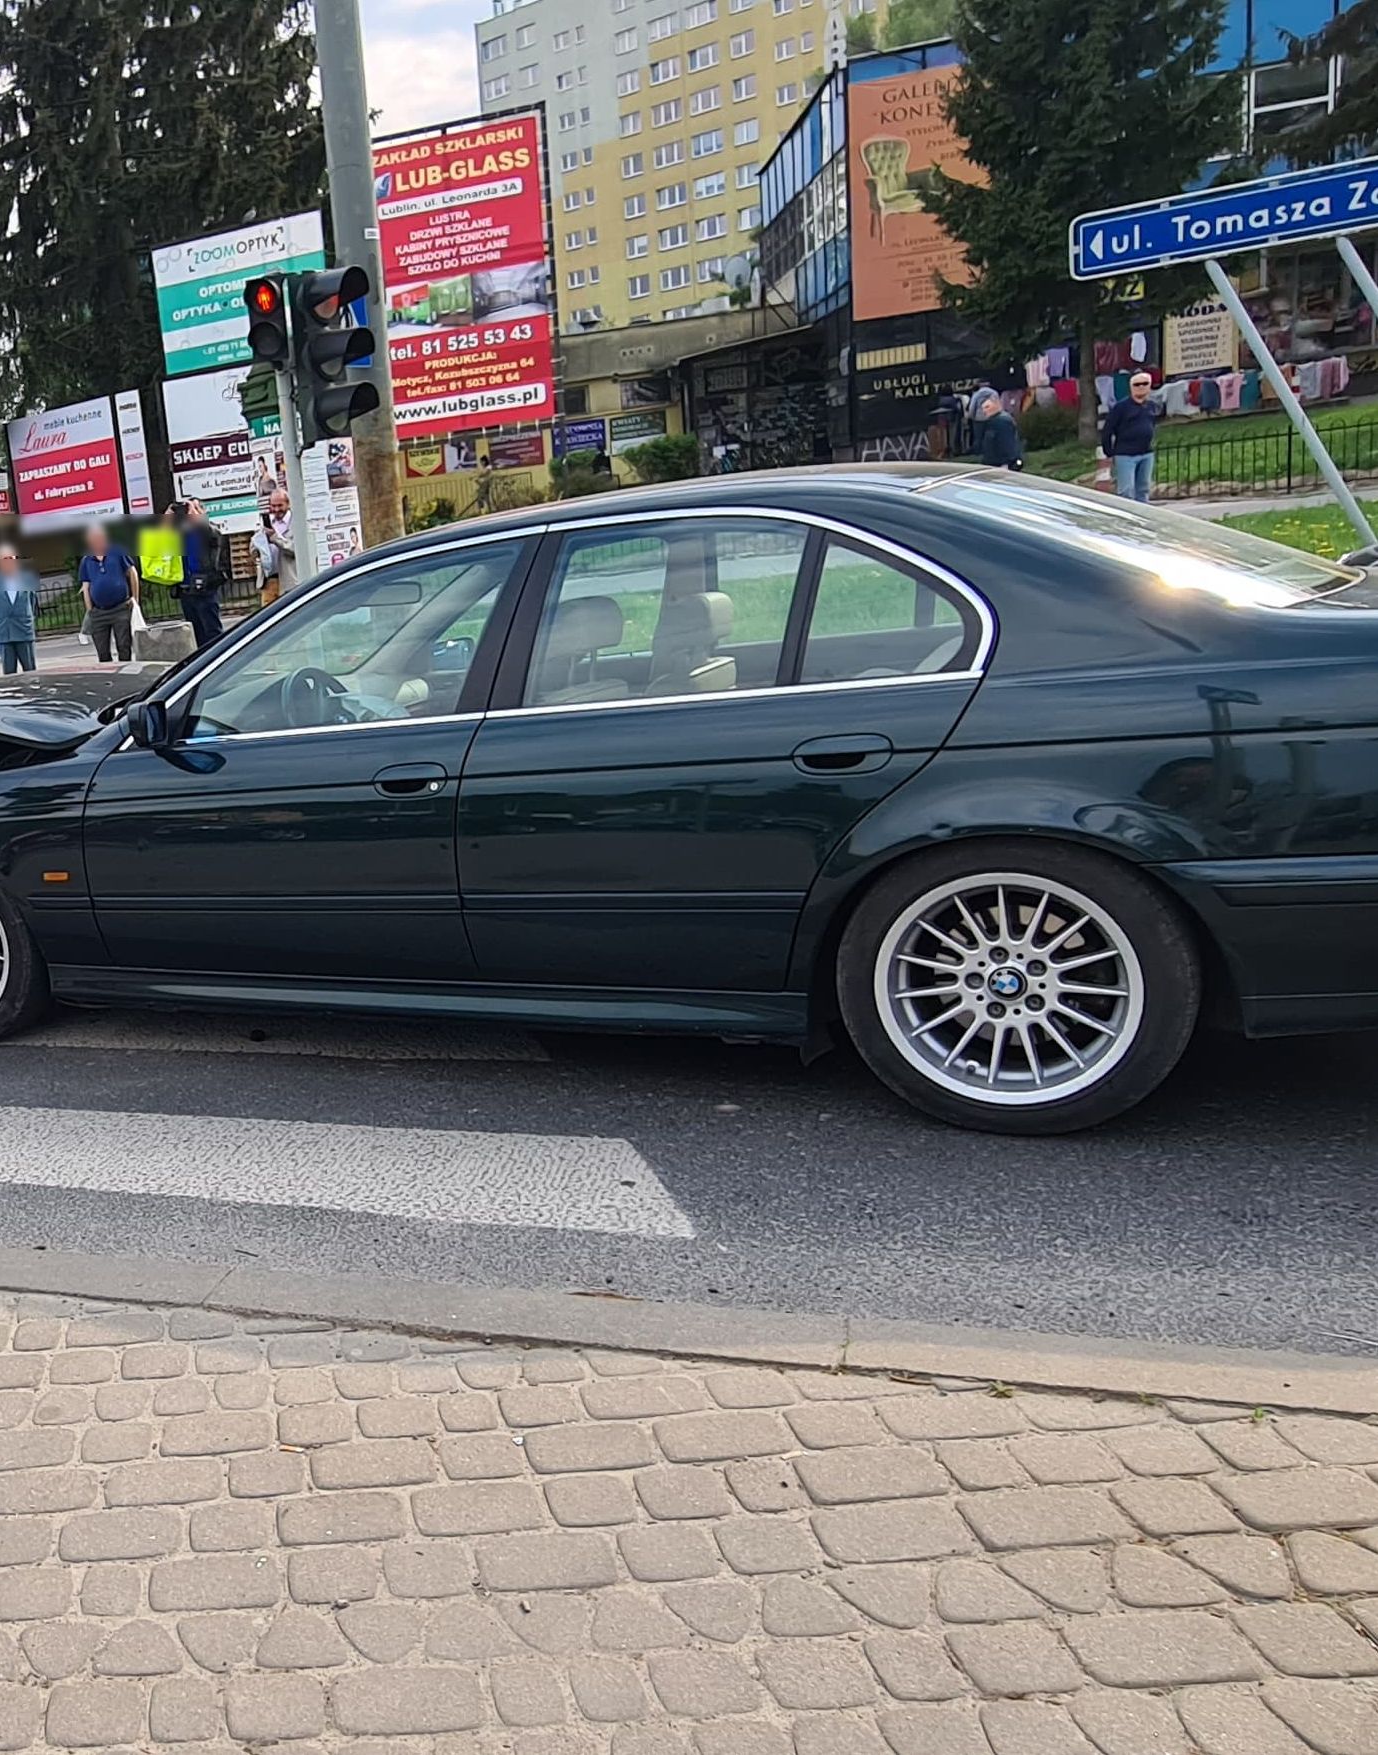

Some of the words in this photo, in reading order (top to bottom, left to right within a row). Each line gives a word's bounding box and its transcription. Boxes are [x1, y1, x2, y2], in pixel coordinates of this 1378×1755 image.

[881, 101, 947, 125] KONES
[373, 146, 431, 168] ZAKŁAD
[434, 126, 523, 155] SZKLARSKI
[395, 148, 531, 192] LUB-GLASS
[424, 197, 437, 208] ul.
[442, 187, 498, 204] Leonarda
[501, 182, 518, 193] 3A
[410, 226, 443, 241] DRZWI
[445, 217, 493, 233] SZKLANE
[429, 210, 471, 226] LUSTRA
[1112, 224, 1153, 254] ul.
[1172, 196, 1331, 242] Tomasza
[193, 233, 280, 265] ZOOMOPTYK
[395, 240, 432, 255] KABINY
[435, 225, 510, 248] PRYSZNICOWE
[399, 248, 458, 266] ZABUDOWY
[459, 238, 508, 255] SZKLANE
[408, 261, 441, 275] SZKŁO
[443, 258, 459, 269] DO
[461, 251, 501, 266] KUCHNI
[172, 299, 222, 322] OPTYKA
[390, 344, 417, 360] tel.
[422, 339, 442, 355] 81
[448, 333, 479, 350] 525
[484, 328, 505, 345] 53
[510, 324, 532, 340] 43
[424, 352, 497, 370] PRODUKCJA:
[392, 374, 432, 389] Motycz,
[873, 373, 926, 390] USŁUGI
[394, 387, 538, 419] www.lubglass.pl
[19, 422, 67, 454] Laura
[173, 444, 222, 465] SKLEP
[19, 462, 71, 482] ZAPRASZAMY
[73, 458, 87, 471] DO
[34, 490, 44, 500] ul.
[45, 484, 86, 499] Fabryczna
